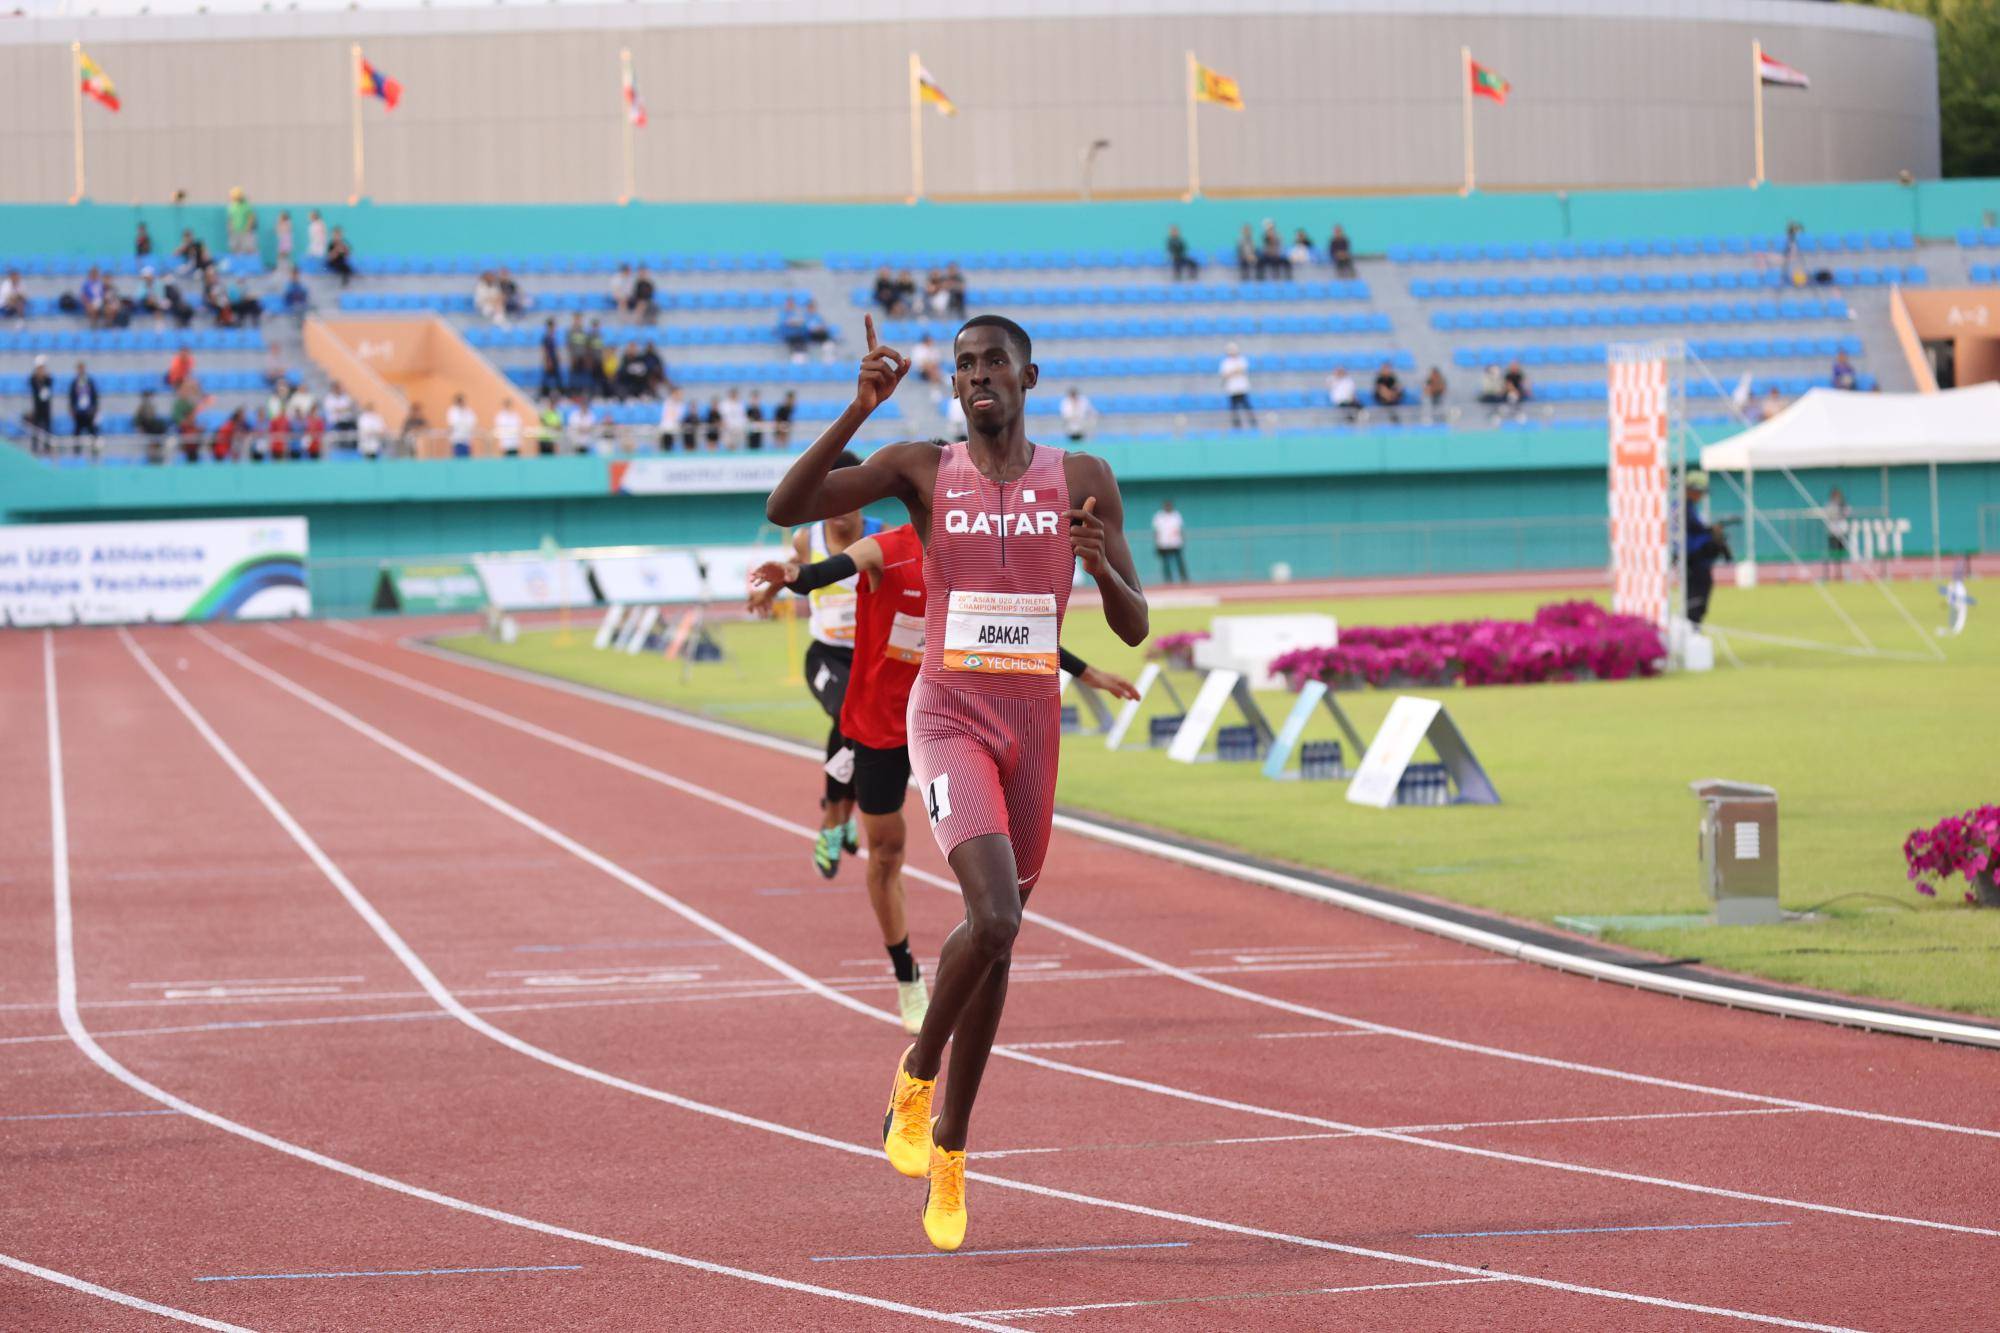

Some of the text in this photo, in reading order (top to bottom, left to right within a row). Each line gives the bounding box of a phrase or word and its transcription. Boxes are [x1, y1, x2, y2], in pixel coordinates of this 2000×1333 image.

[945, 510, 1059, 537] QATAR
[27, 546, 81, 565] U20
[91, 544, 205, 562] Athletics
[92, 575, 202, 592] Yecheon
[958, 603, 1017, 611] CHAMPIONSHIPS
[978, 624, 1030, 645] ABAKAR
[986, 657, 1046, 670] YECHEON
[929, 782, 940, 823] 4
